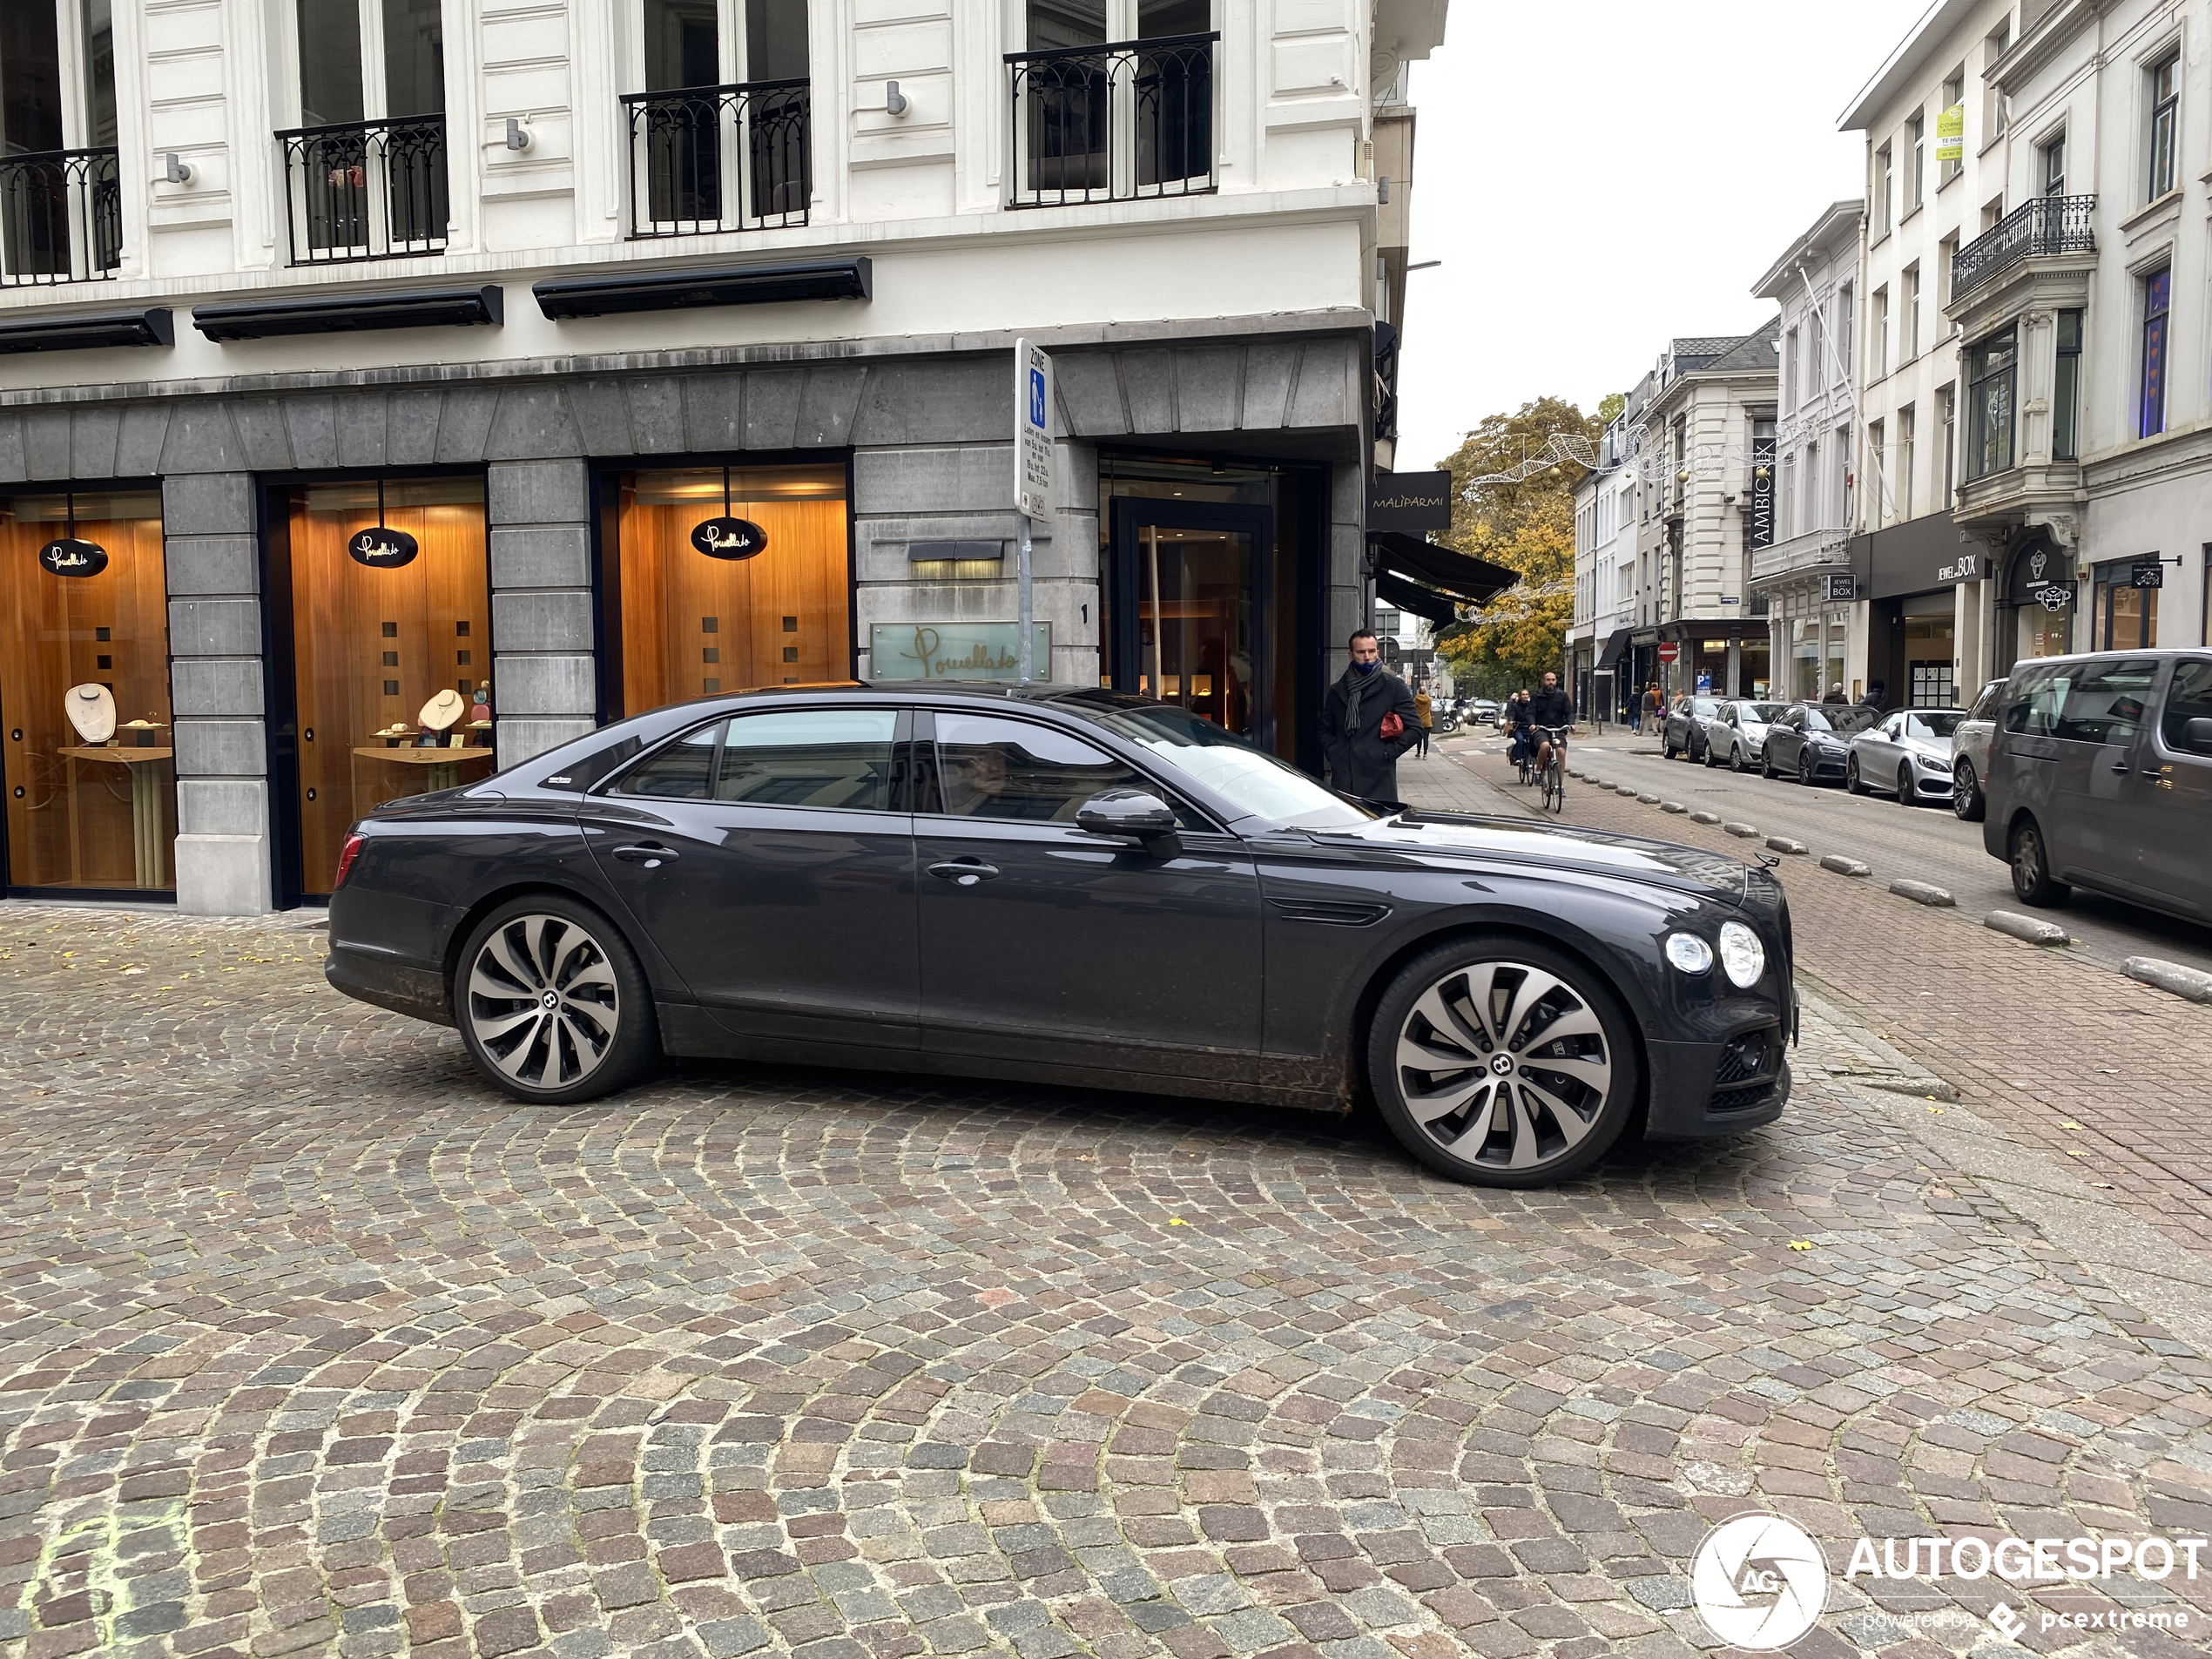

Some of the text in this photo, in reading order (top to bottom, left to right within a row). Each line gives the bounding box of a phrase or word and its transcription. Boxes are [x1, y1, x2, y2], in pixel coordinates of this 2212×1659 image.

[1030, 347, 1045, 373] ZONE
[1024, 422, 1051, 445] Laden en lossen
[1028, 470, 1036, 483] Max.
[1938, 554, 1976, 581] JEWEL BOX
[1832, 587, 1851, 596] BOX
[1081, 604, 1088, 624] 1
[900, 625, 1020, 678] Pomellato
